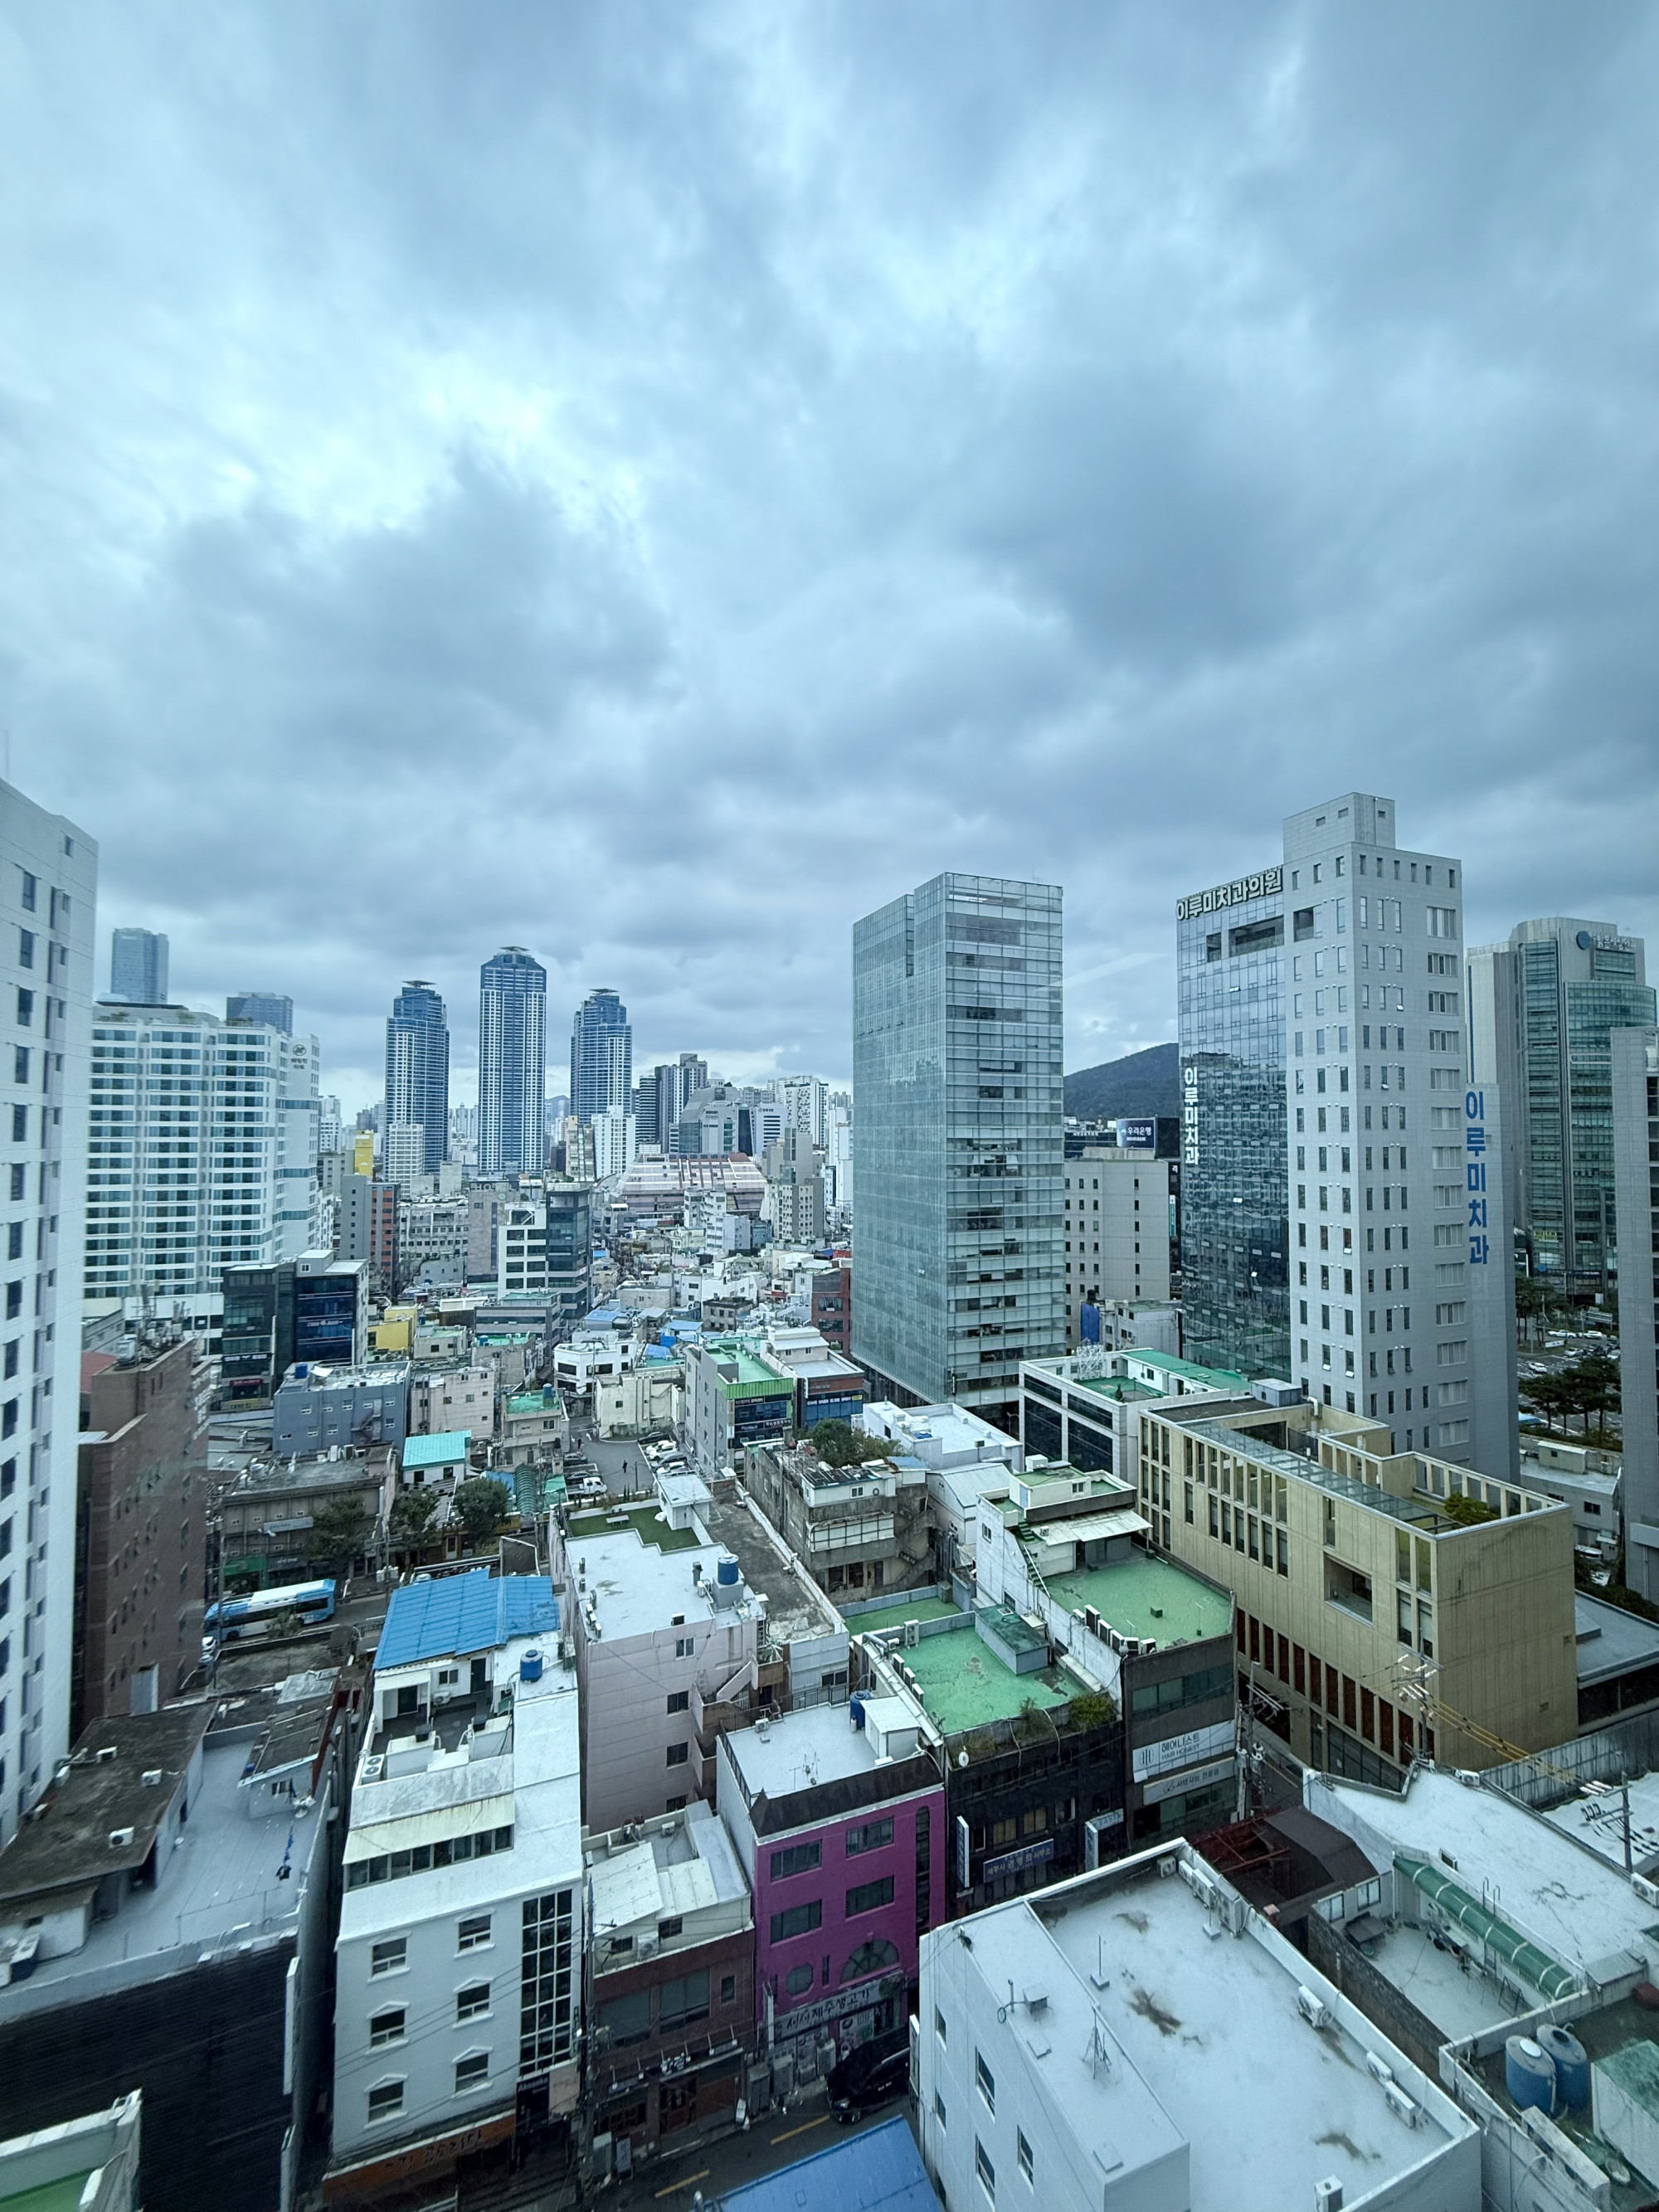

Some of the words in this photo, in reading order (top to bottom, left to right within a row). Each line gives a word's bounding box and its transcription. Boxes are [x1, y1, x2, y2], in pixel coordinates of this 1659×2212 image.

[1176, 867, 1282, 921] 이루미치과의원
[1127, 1126, 1151, 1135] 우리은행
[1185, 1066, 1199, 1165] 이루미치과
[1466, 1091, 1489, 1265] 이루미치과
[1161, 1733, 1199, 1753] 헤어니스트
